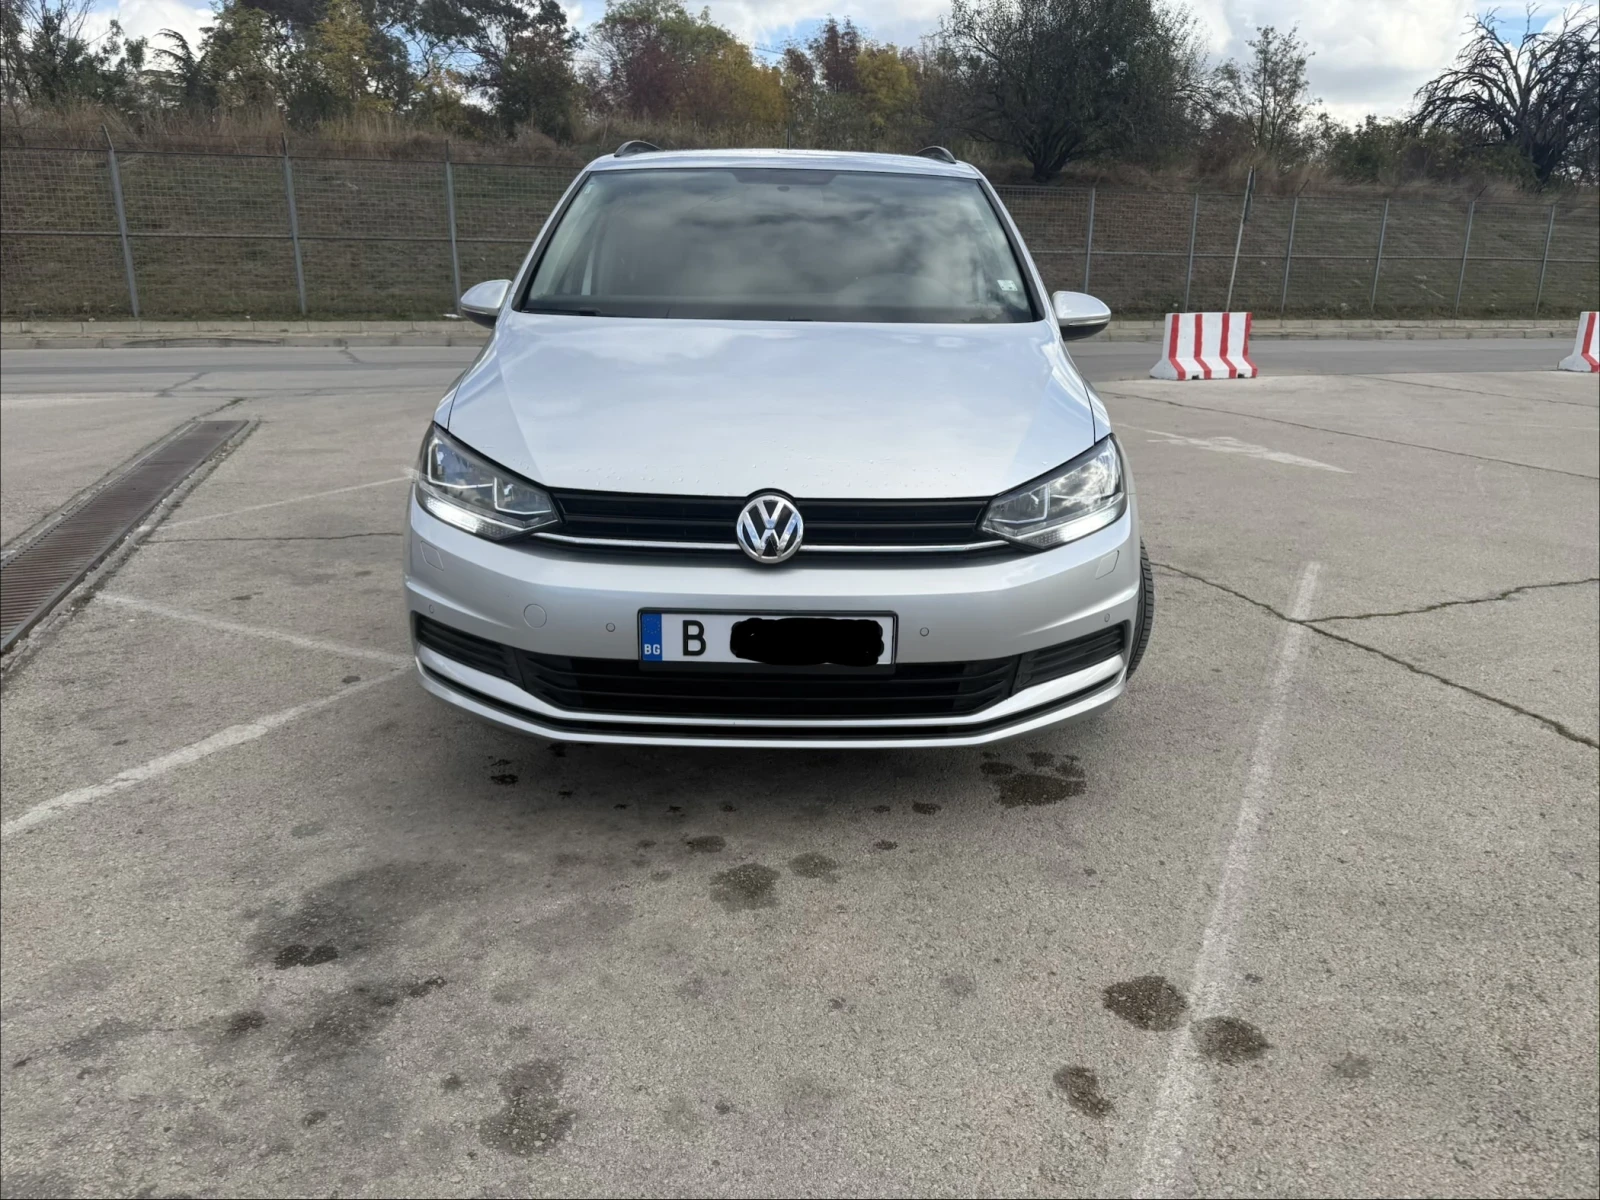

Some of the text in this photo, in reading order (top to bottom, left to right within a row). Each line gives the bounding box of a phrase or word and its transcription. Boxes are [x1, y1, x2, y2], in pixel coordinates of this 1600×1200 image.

[738, 496, 802, 562] VW
[644, 643, 661, 655] BG
[682, 619, 707, 656] B
